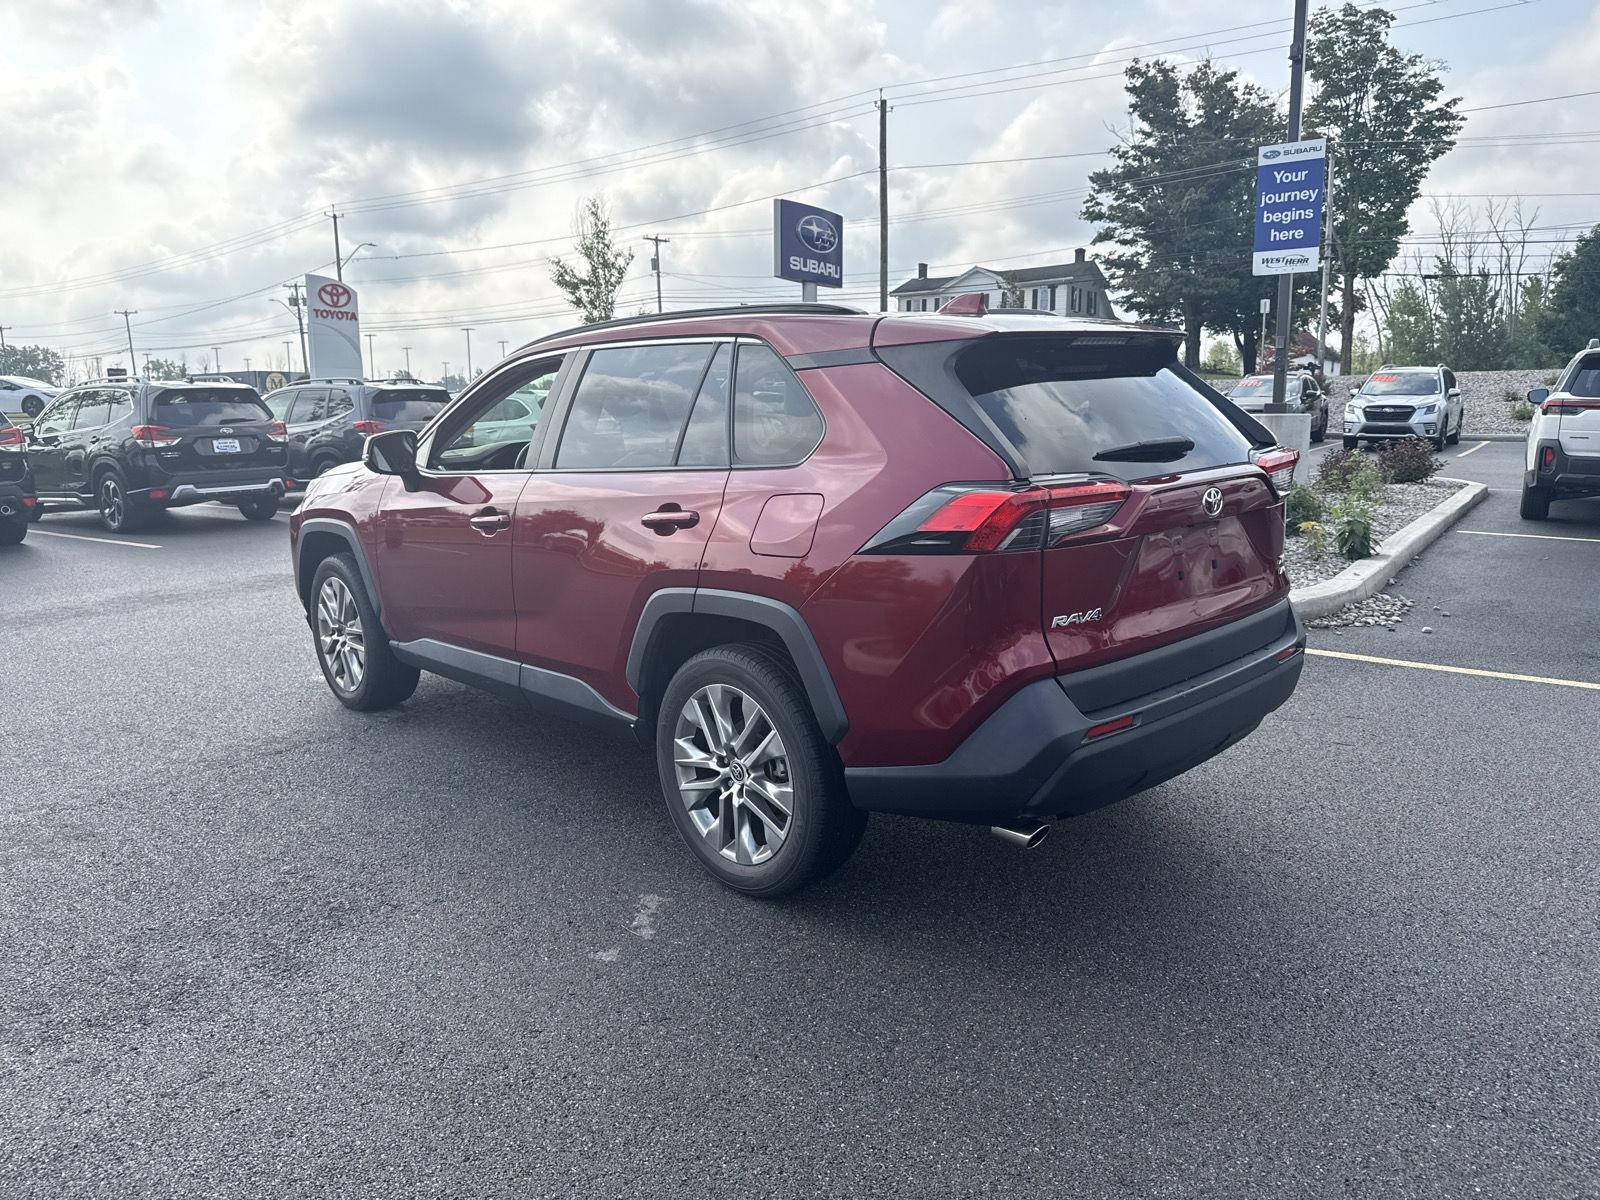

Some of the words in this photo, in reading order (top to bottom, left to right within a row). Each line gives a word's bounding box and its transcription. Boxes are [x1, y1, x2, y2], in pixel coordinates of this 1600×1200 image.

[1283, 146, 1322, 156] SUBARU
[1273, 170, 1309, 184] Your
[1260, 188, 1319, 207] journey
[1263, 208, 1314, 224] begins
[1270, 229, 1304, 242] here
[789, 255, 840, 279] SUBARU
[313, 308, 358, 321] TOYOTA
[1051, 607, 1102, 629] RAV4
